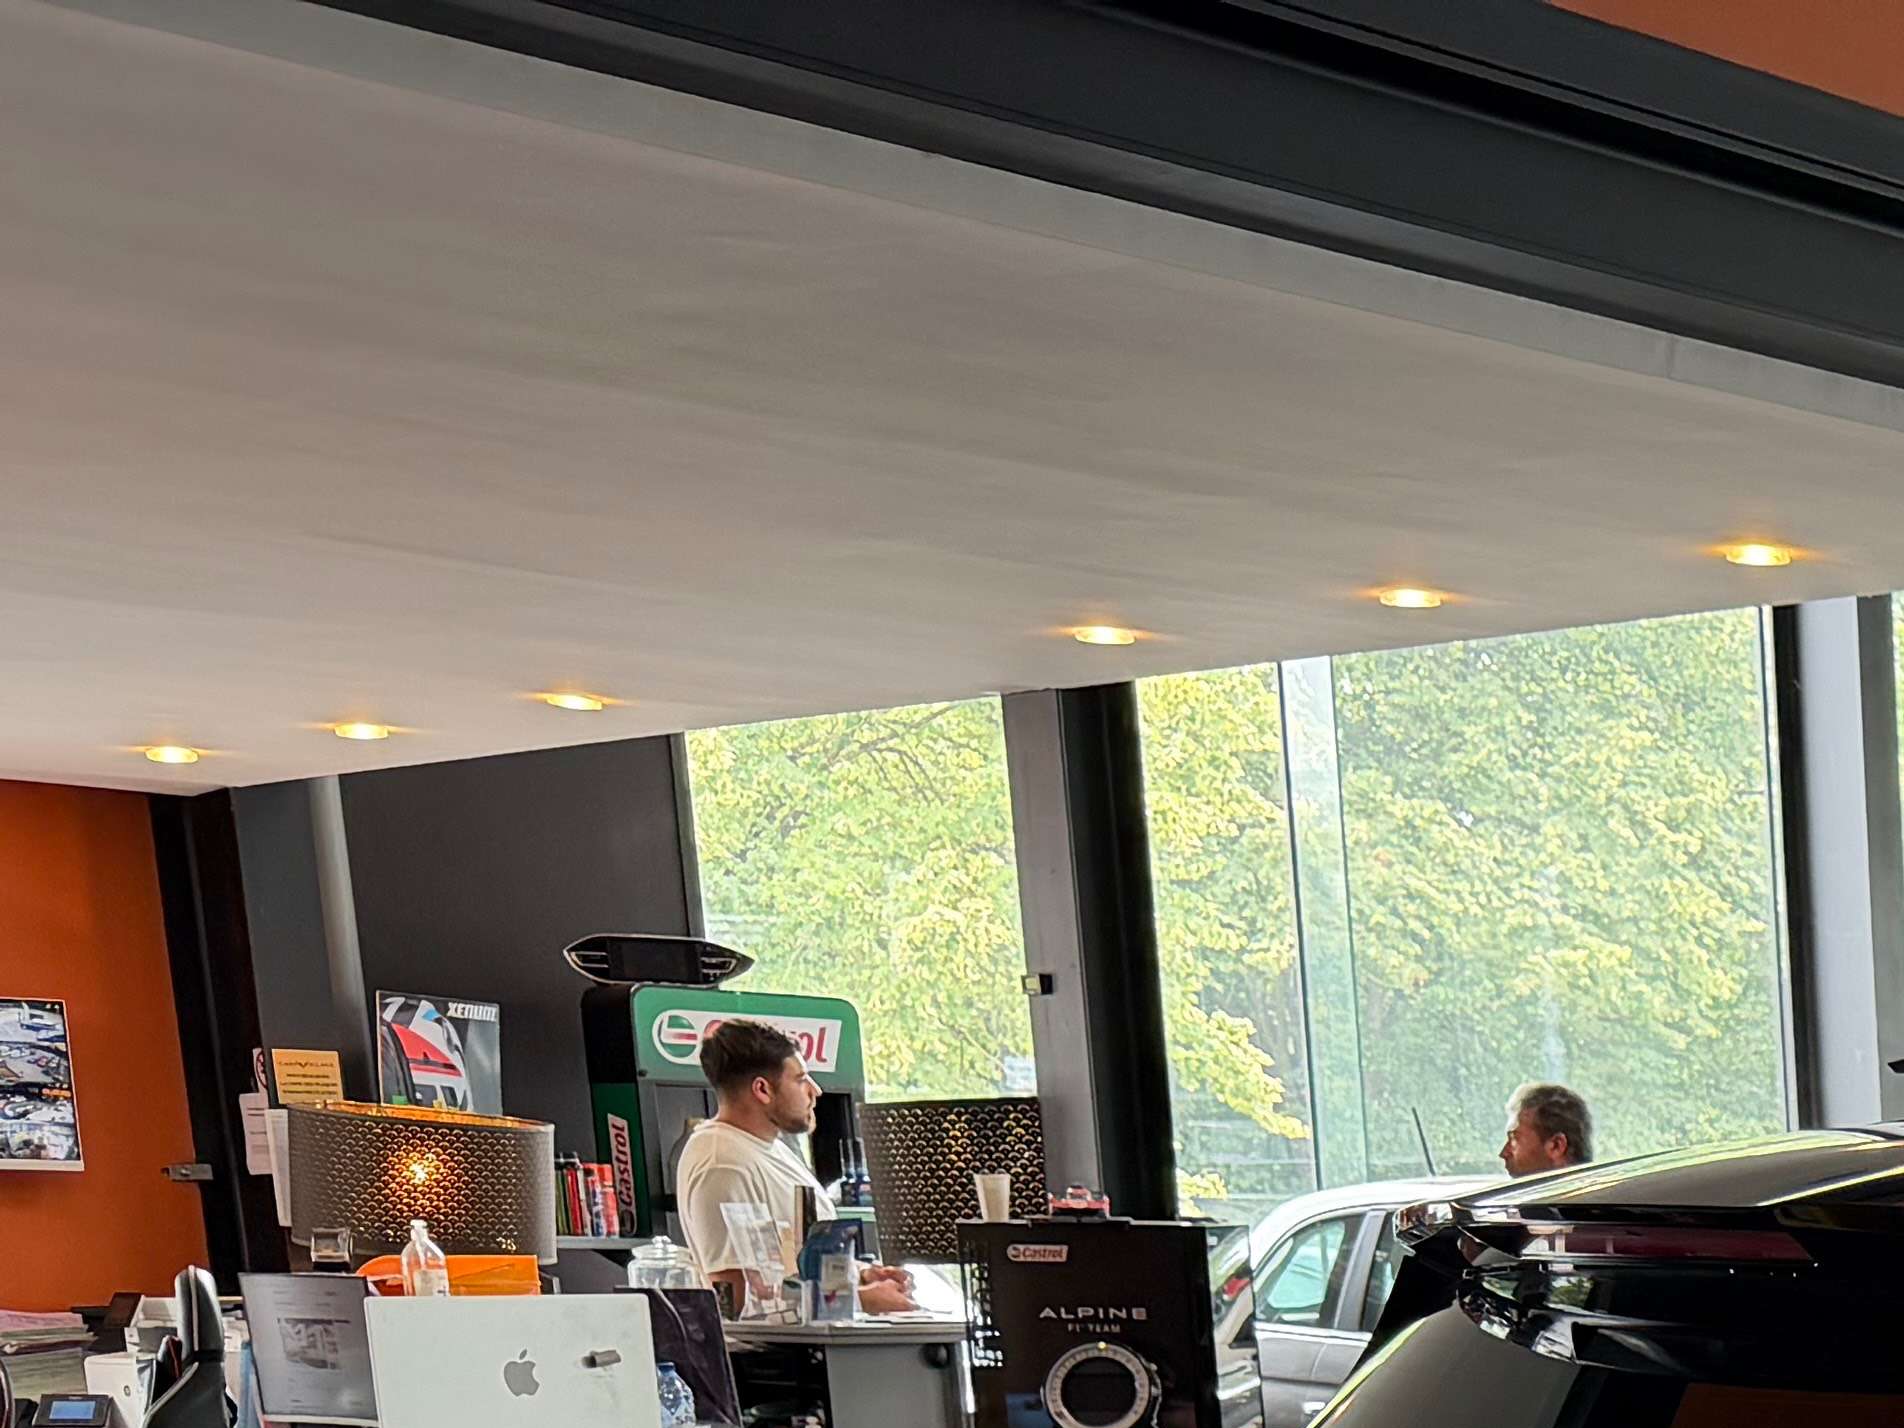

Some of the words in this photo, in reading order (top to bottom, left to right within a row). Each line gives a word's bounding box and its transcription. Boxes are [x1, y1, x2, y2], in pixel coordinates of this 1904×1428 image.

[447, 1002, 497, 1022] XENUM
[611, 1121, 634, 1216] Castrol
[1022, 1247, 1064, 1259] Castrol
[1039, 1306, 1148, 1320] ALPINE
[1088, 1323, 1121, 1333] TEAM
